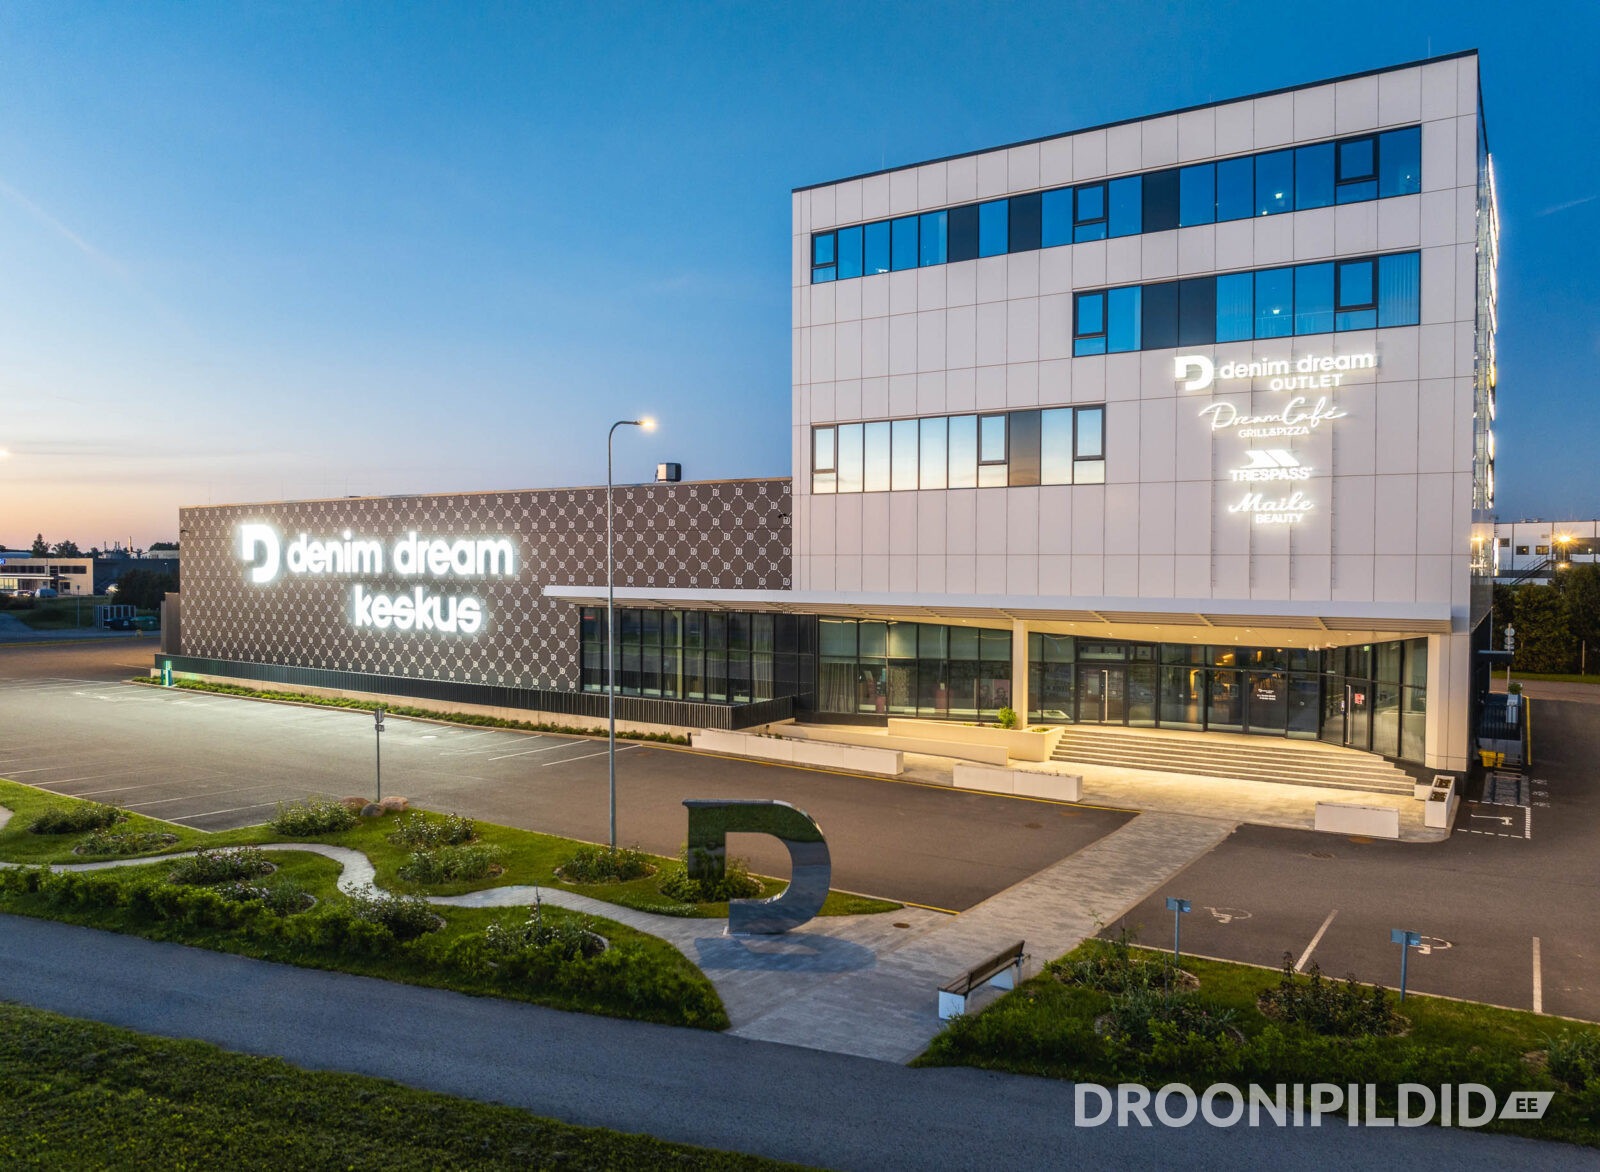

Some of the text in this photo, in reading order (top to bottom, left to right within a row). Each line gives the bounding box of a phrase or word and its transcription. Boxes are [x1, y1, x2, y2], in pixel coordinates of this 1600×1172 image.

[1219, 358, 1290, 380] denim
[1296, 352, 1375, 373] dream
[1270, 373, 1342, 391] OUTLET
[1198, 402, 1283, 431] Dream
[1229, 468, 1310, 482] TRESPASS
[1228, 491, 1315, 512] Maile
[1255, 512, 1304, 524] BEAUTY
[286, 530, 383, 574] denim
[393, 531, 513, 576] dream
[354, 584, 482, 634] keskus
